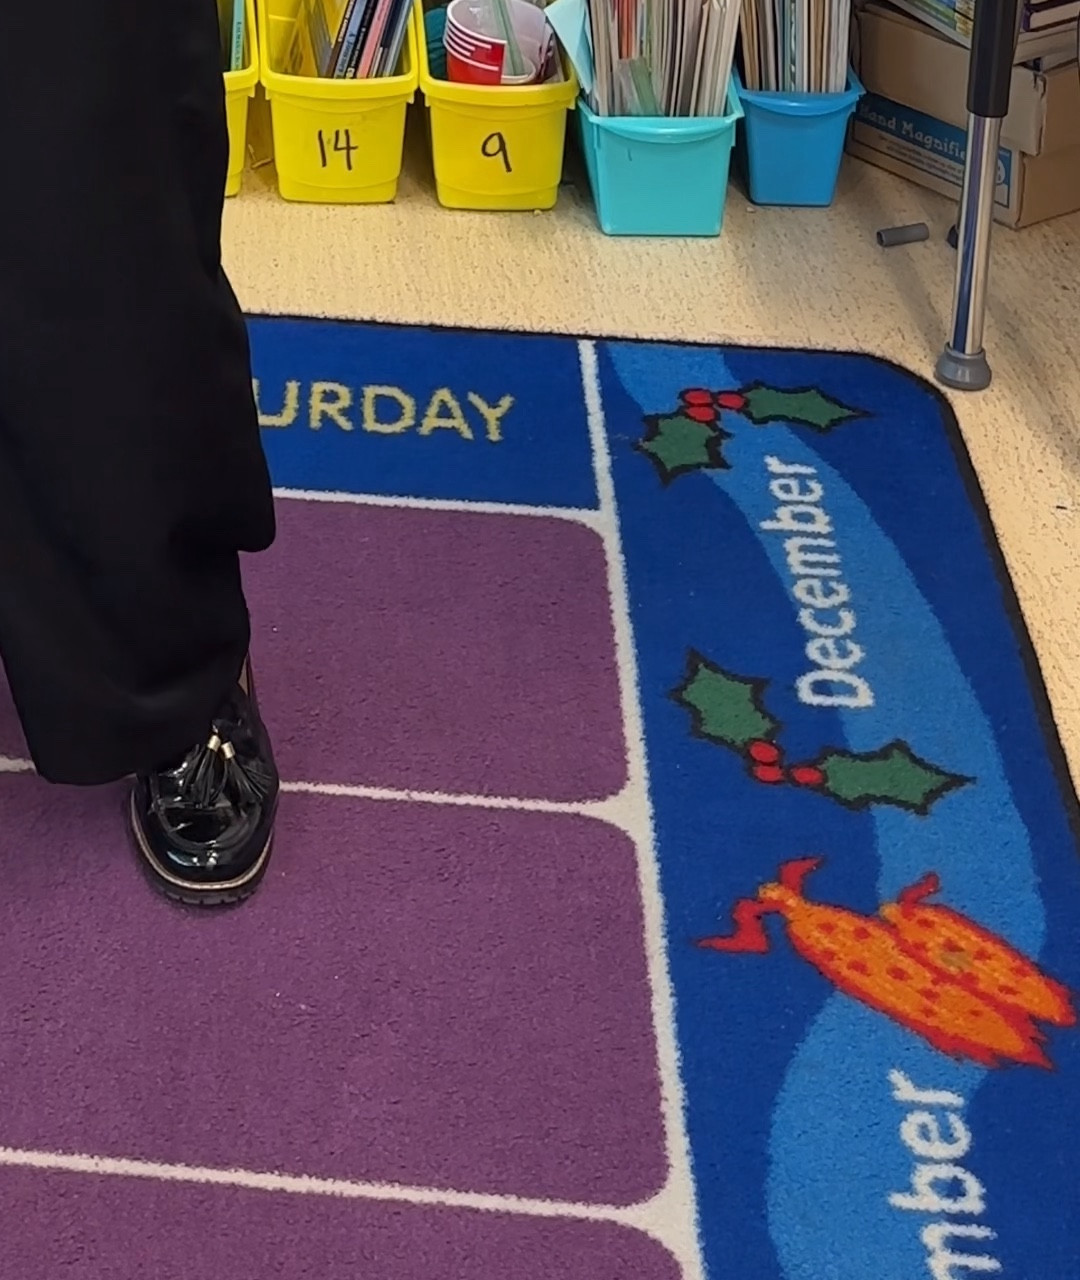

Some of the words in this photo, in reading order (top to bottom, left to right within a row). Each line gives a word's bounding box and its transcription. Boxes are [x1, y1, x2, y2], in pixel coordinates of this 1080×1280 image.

[317, 128, 359, 171] 14
[481, 132, 513, 174] 9
[761, 452, 876, 710] December
